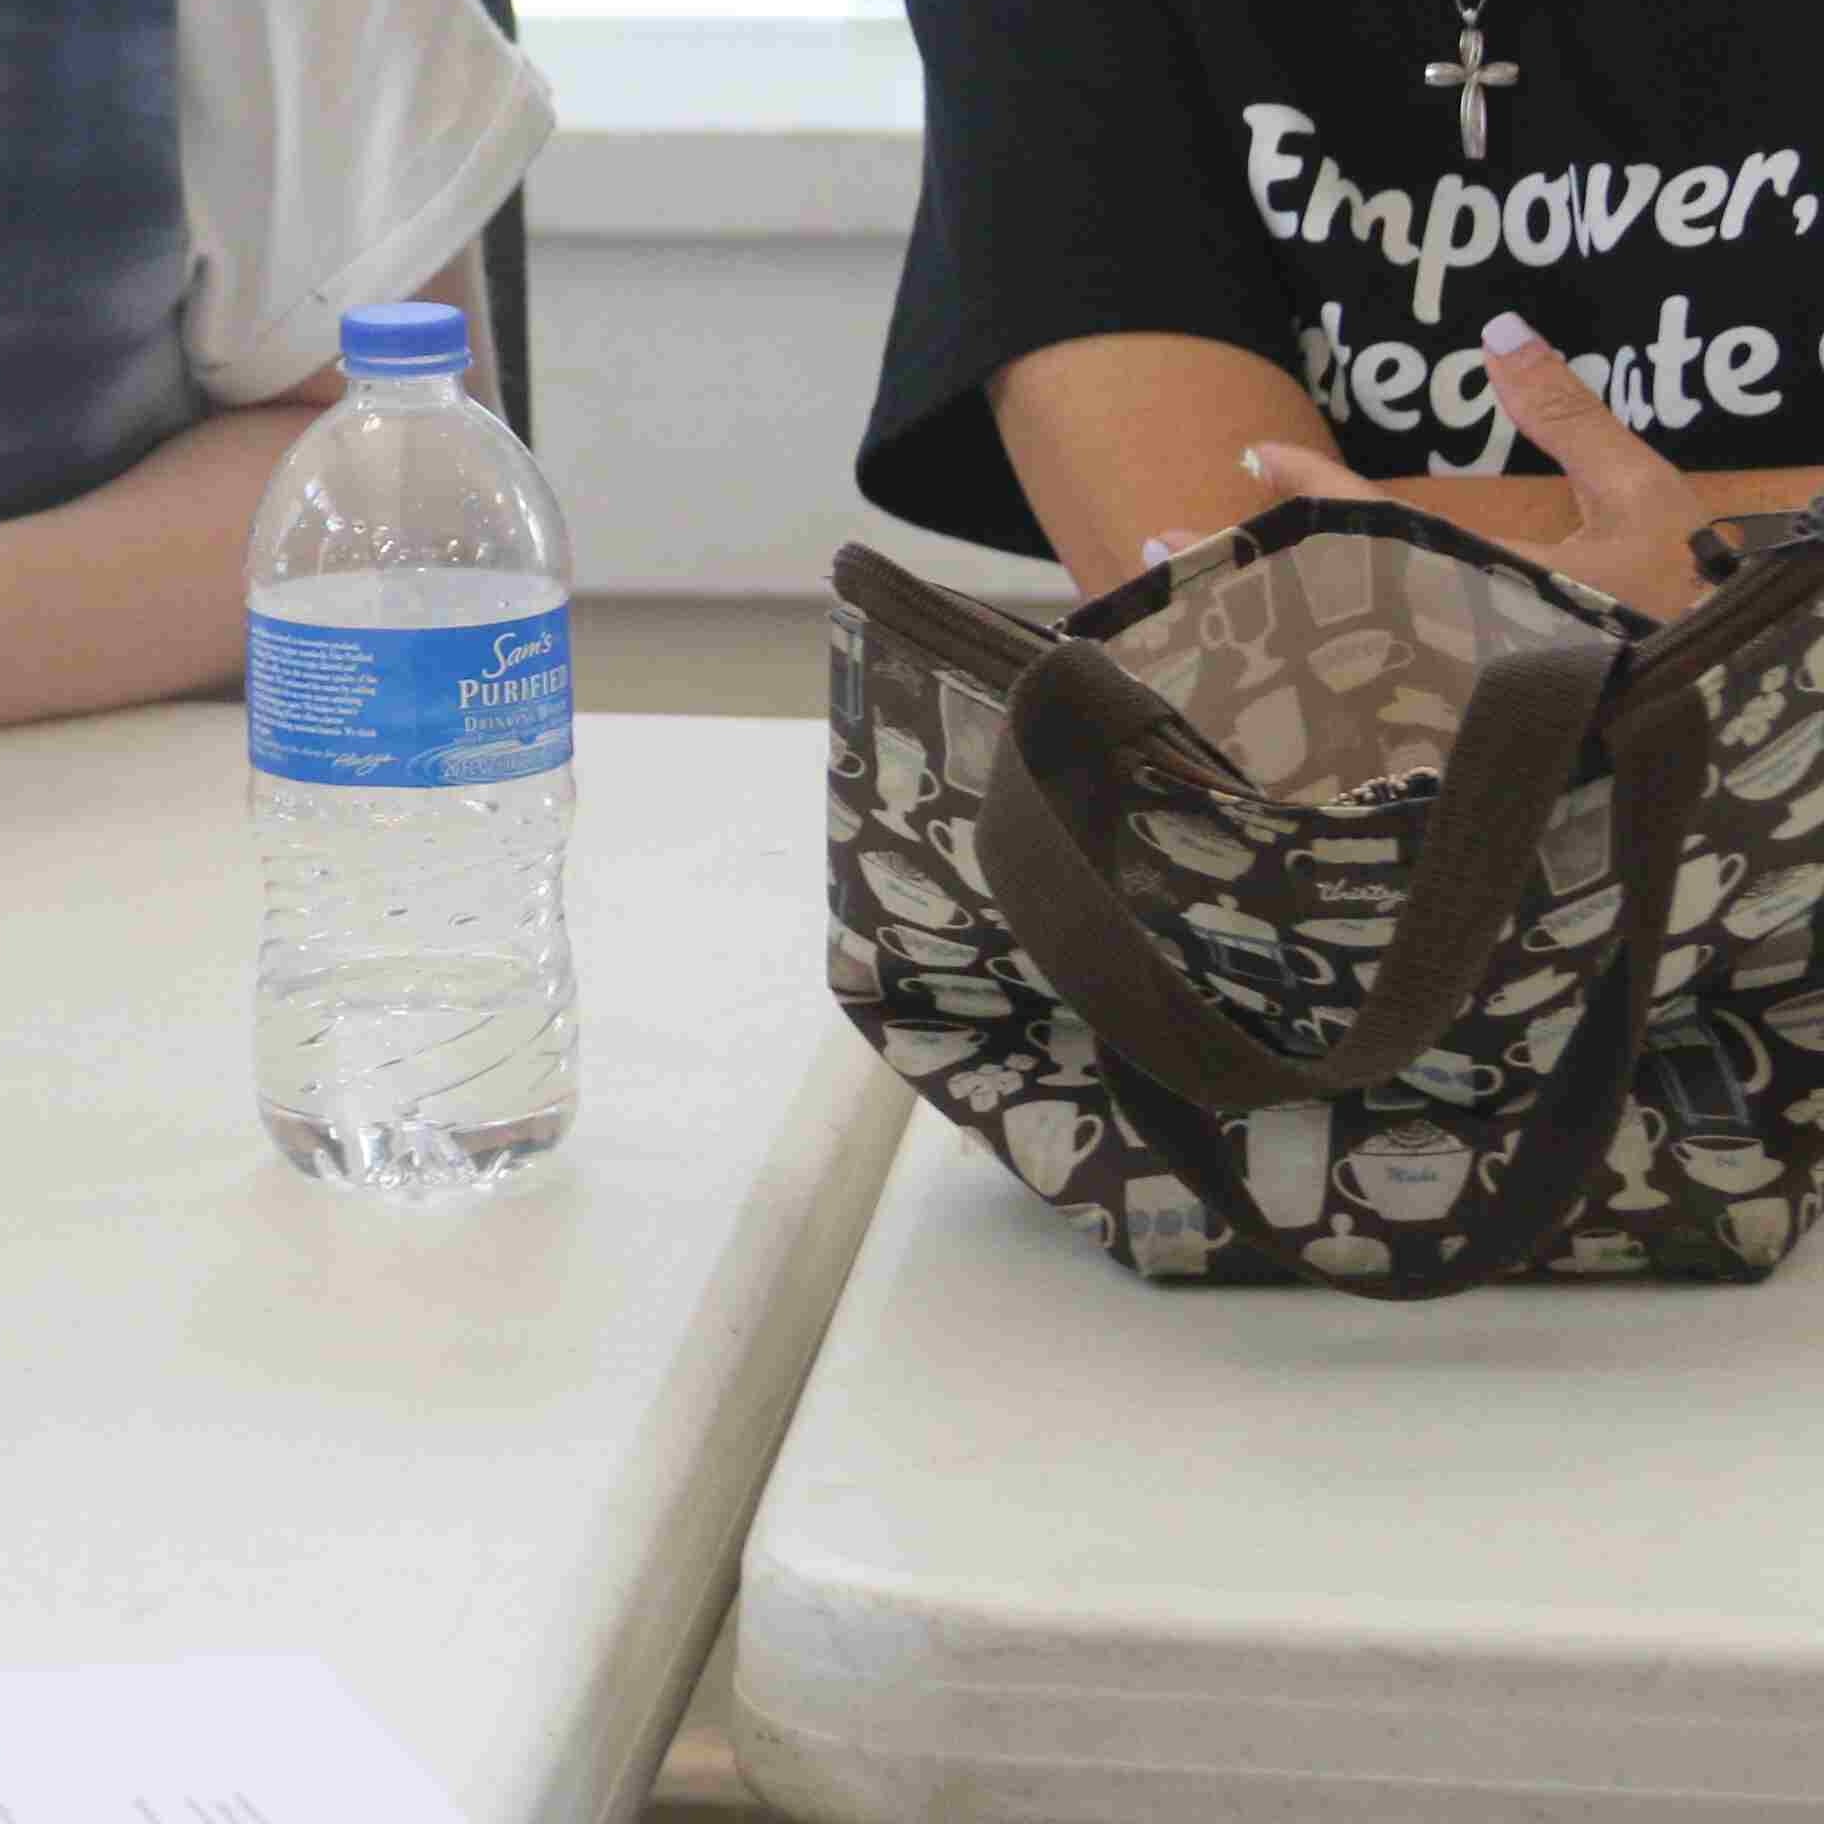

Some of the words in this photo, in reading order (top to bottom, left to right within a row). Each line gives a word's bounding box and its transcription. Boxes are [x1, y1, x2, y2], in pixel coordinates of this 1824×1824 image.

[1243, 102, 1818, 324] Empower,
[1296, 294, 1783, 476] tegate
[482, 631, 554, 679] Sam's
